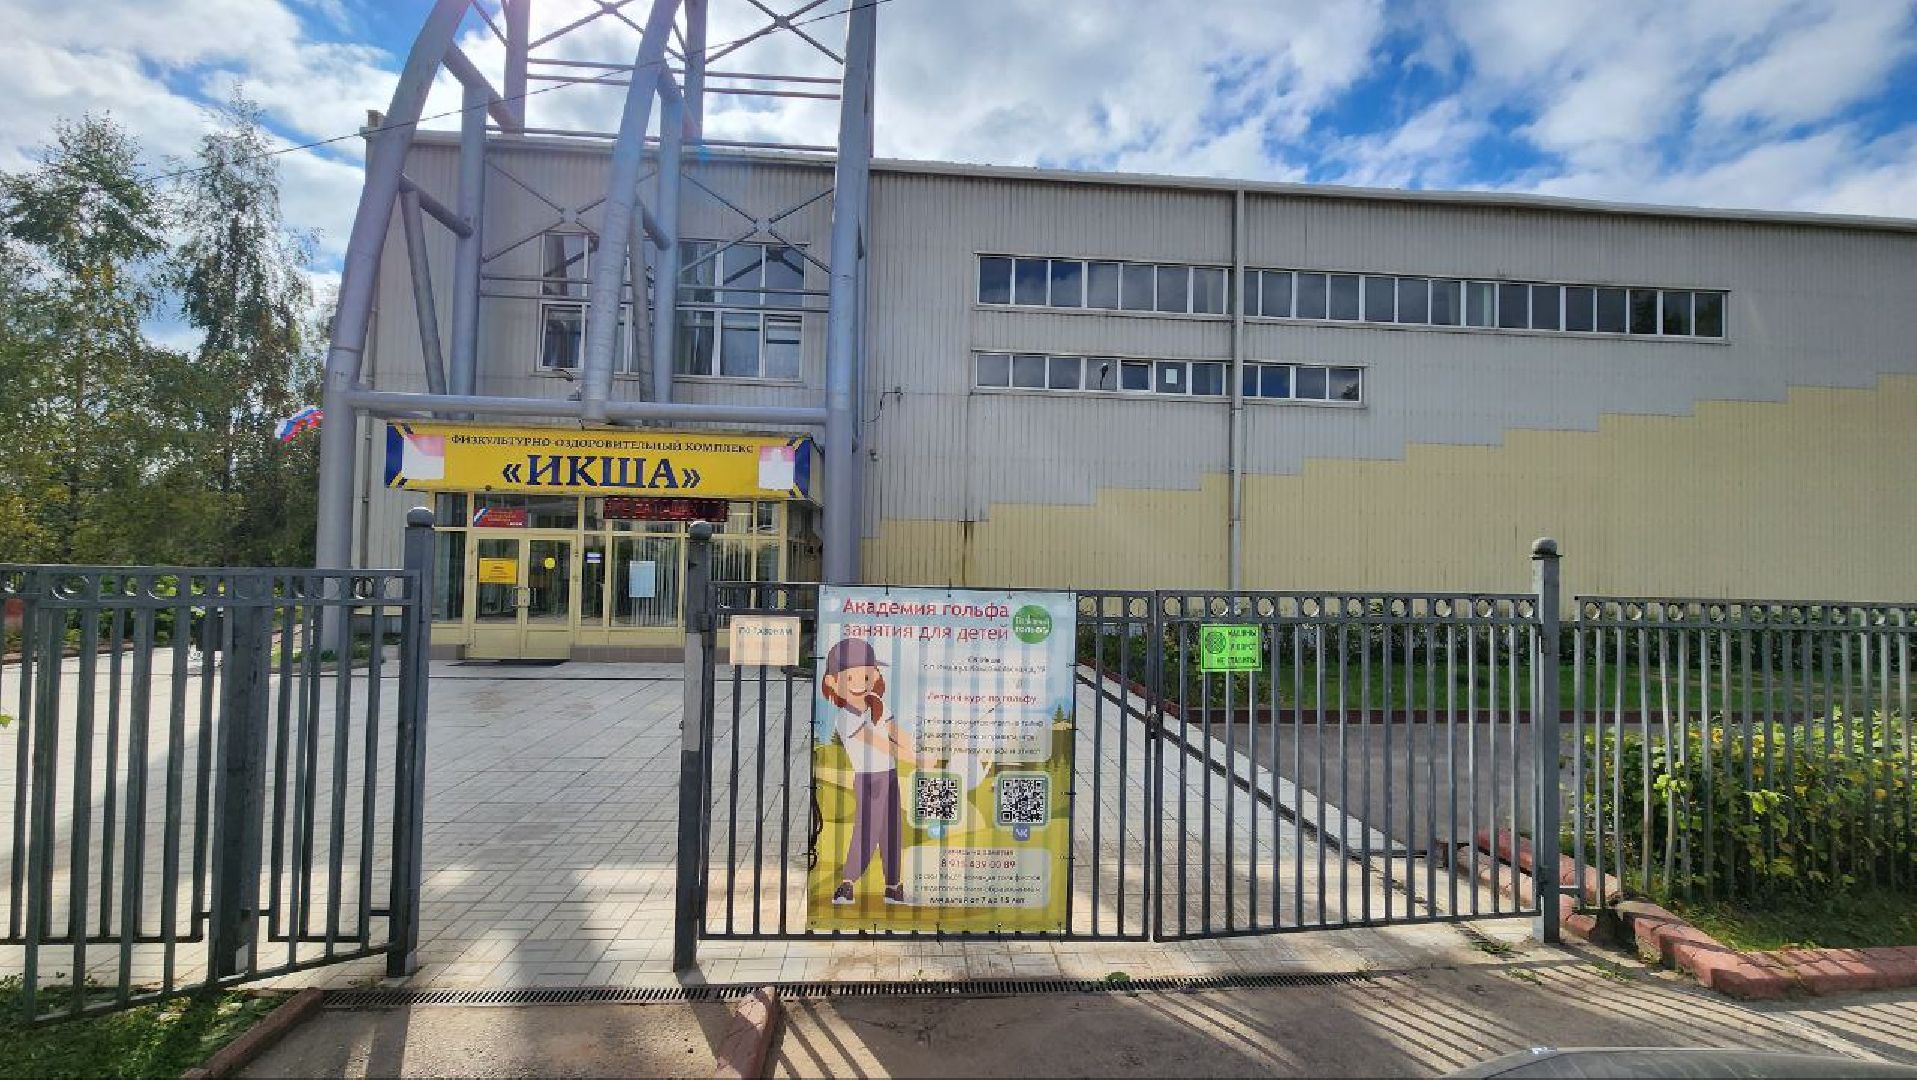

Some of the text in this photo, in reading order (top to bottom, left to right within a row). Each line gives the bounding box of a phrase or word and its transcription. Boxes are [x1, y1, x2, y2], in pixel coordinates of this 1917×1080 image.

[685, 441, 753, 453] КОМПЛЕКС
[502, 454, 700, 489] «ИКША»
[843, 597, 936, 617] Академия
[943, 602, 1009, 621] гольфа
[919, 626, 951, 641] для
[957, 623, 1008, 642] детей
[1002, 694, 1037, 705] гольфу
[941, 858, 947, 868] 8
[970, 860, 987, 869] 439
[1003, 860, 1016, 869] 89
[1001, 896, 1010, 904] 15
